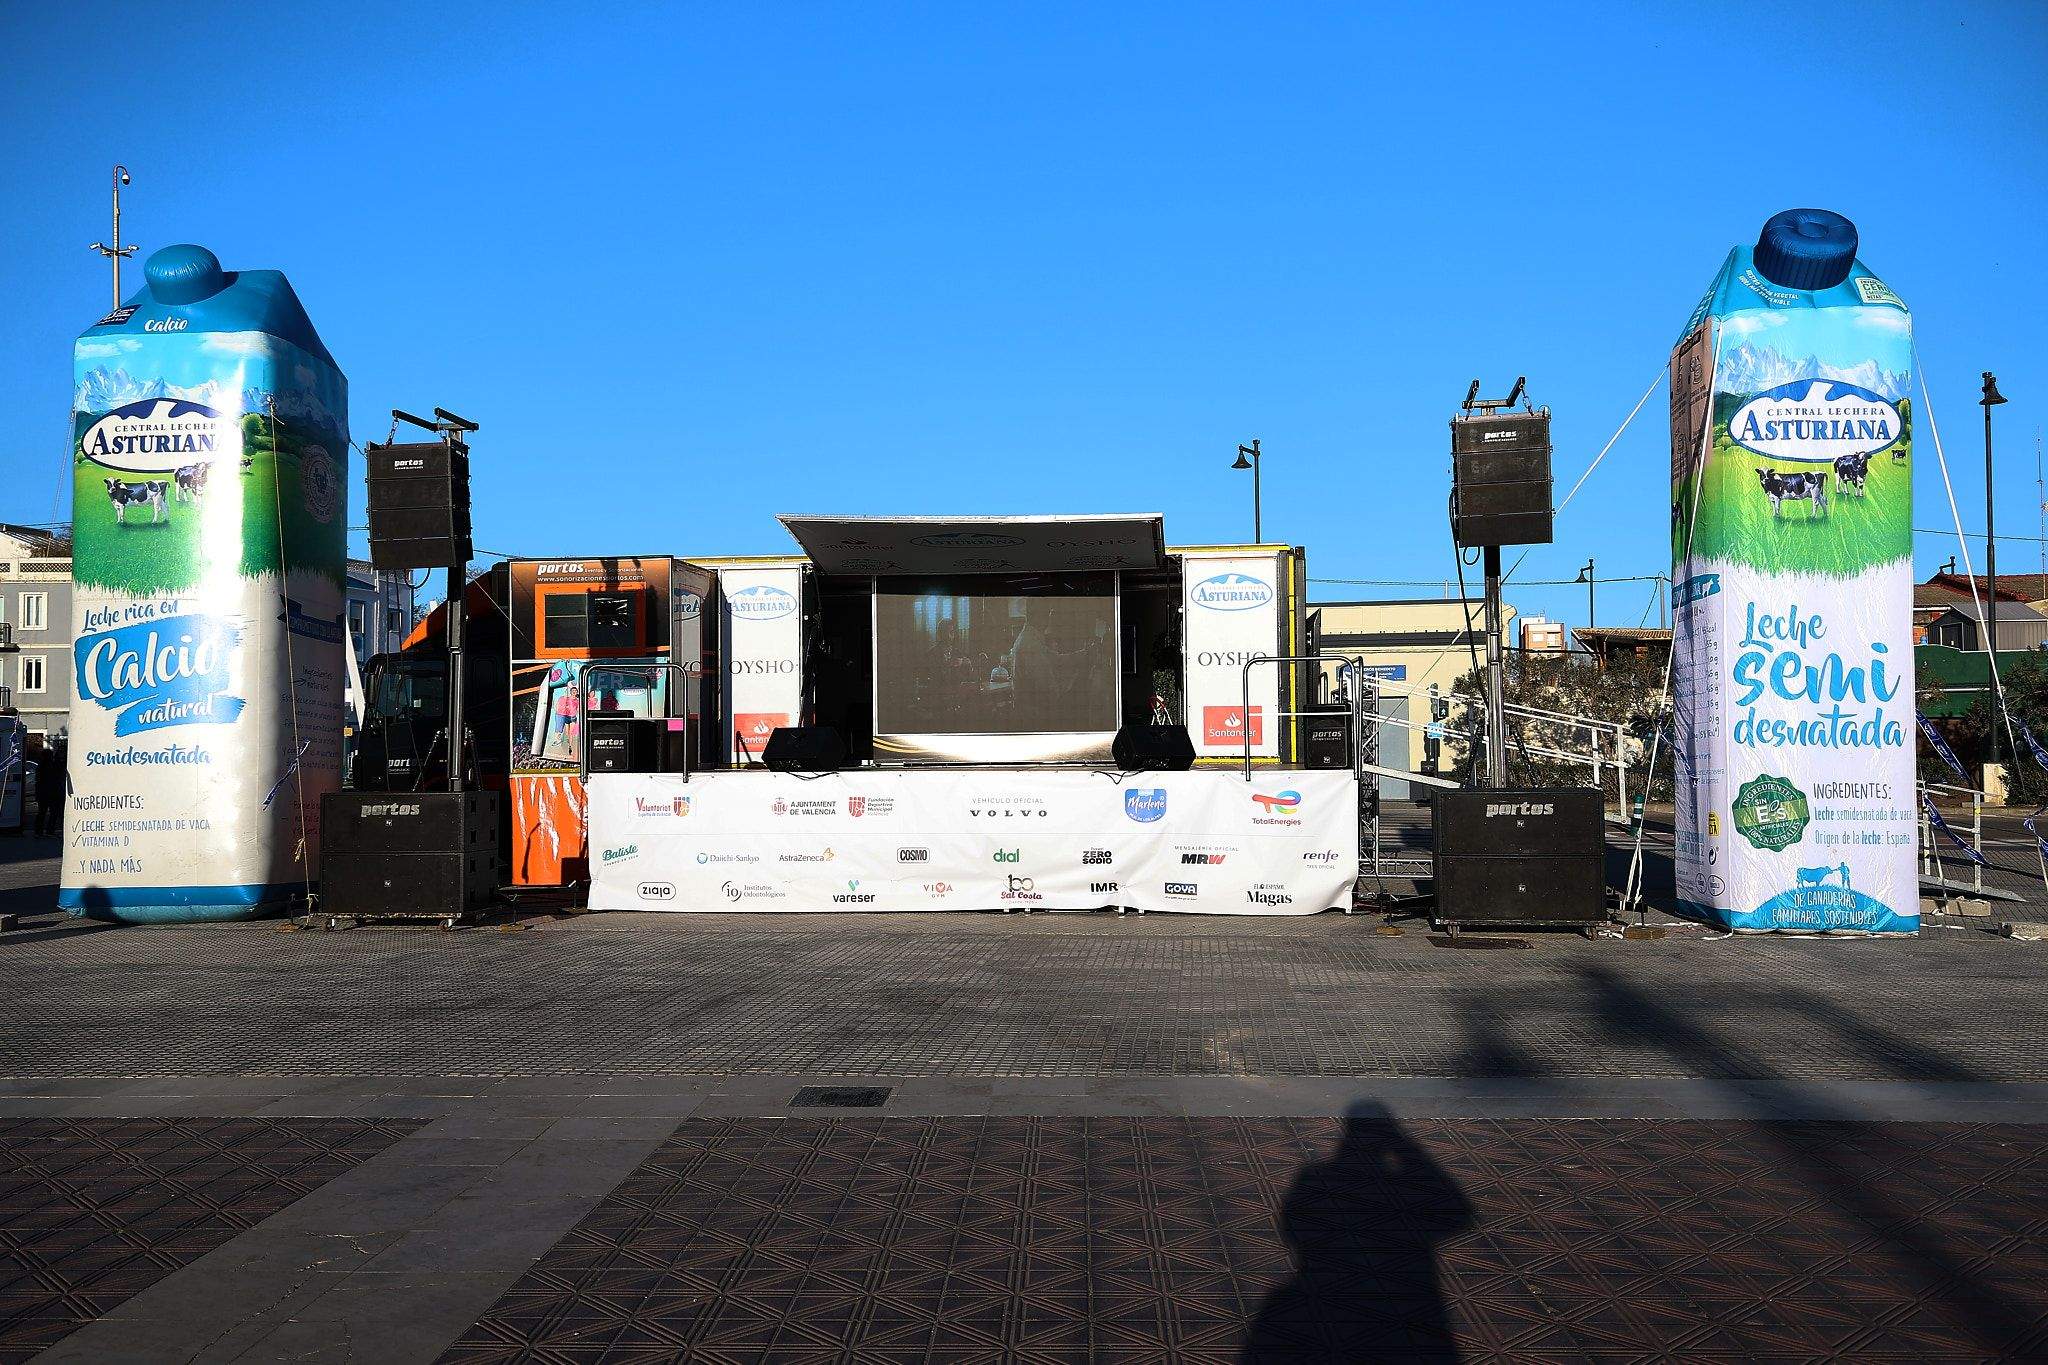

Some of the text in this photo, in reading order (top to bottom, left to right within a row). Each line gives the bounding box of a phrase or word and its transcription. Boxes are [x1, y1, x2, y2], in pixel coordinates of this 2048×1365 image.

[1767, 407, 1886, 416] CENTRAL LECHERA
[114, 424, 166, 433] CENTRAL
[1739, 409, 1892, 441] ASTURIANA
[394, 459, 424, 467] portos
[538, 562, 584, 575] portos
[1197, 586, 1267, 602] ASTURIANA
[82, 600, 179, 633] Leche rica en
[1738, 601, 1828, 653] Leche
[84, 631, 216, 699] Calcio
[1197, 651, 1267, 667] OYSHO
[729, 659, 794, 675] OYSHO
[1733, 642, 1901, 706] semi
[138, 693, 214, 724] natural
[1733, 704, 1907, 749] desnatada
[593, 738, 625, 746] portos
[86, 743, 212, 767] semidesnatada
[1742, 783, 1795, 807] INGREDIENTES
[1813, 782, 1892, 800] INGREDIENTES:
[73, 794, 145, 810] INGREDIENTES:
[1127, 794, 1165, 814] Marlene
[1754, 797, 1768, 806] SIN
[360, 802, 420, 818] portos
[970, 809, 1048, 817] VOLVO
[1486, 802, 1554, 818] portos
[1836, 806, 1888, 821] semidesnatada
[1890, 806, 1898, 821] de
[81, 819, 211, 832] LECHE SEMIDESNATADA DE VACA
[1252, 817, 1302, 827] TotalEnergies
[1763, 821, 1800, 844] NATURALES
[1815, 829, 1840, 848] Origen
[1842, 830, 1851, 845] de
[81, 835, 130, 847] VITAMINA D
[602, 844, 639, 861] Batiste
[709, 853, 760, 864] Daiichi-Sankyo
[778, 854, 825, 862] AstraZeneca
[900, 849, 928, 861] COSMO
[993, 848, 1020, 863] dial
[1082, 850, 1112, 858] ZERO
[1181, 853, 1226, 864] MRW
[1303, 849, 1339, 864] renfe
[89, 859, 116, 874] NADA
[120, 855, 142, 873] MÁS
[1082, 857, 1113, 865] SODIO
[642, 886, 671, 898] ziaja
[726, 885, 739, 898] io
[743, 891, 786, 899] Odontológicos
[1090, 882, 1118, 893] IMR
[1166, 884, 1197, 894] GOYA
[832, 894, 876, 903] vareser
[1001, 891, 1043, 900] Sal Costa
[1247, 890, 1293, 907] Magas
[1794, 893, 1804, 908] DE
[1772, 908, 1878, 926] FAMILIARES SOSTENIBLES
